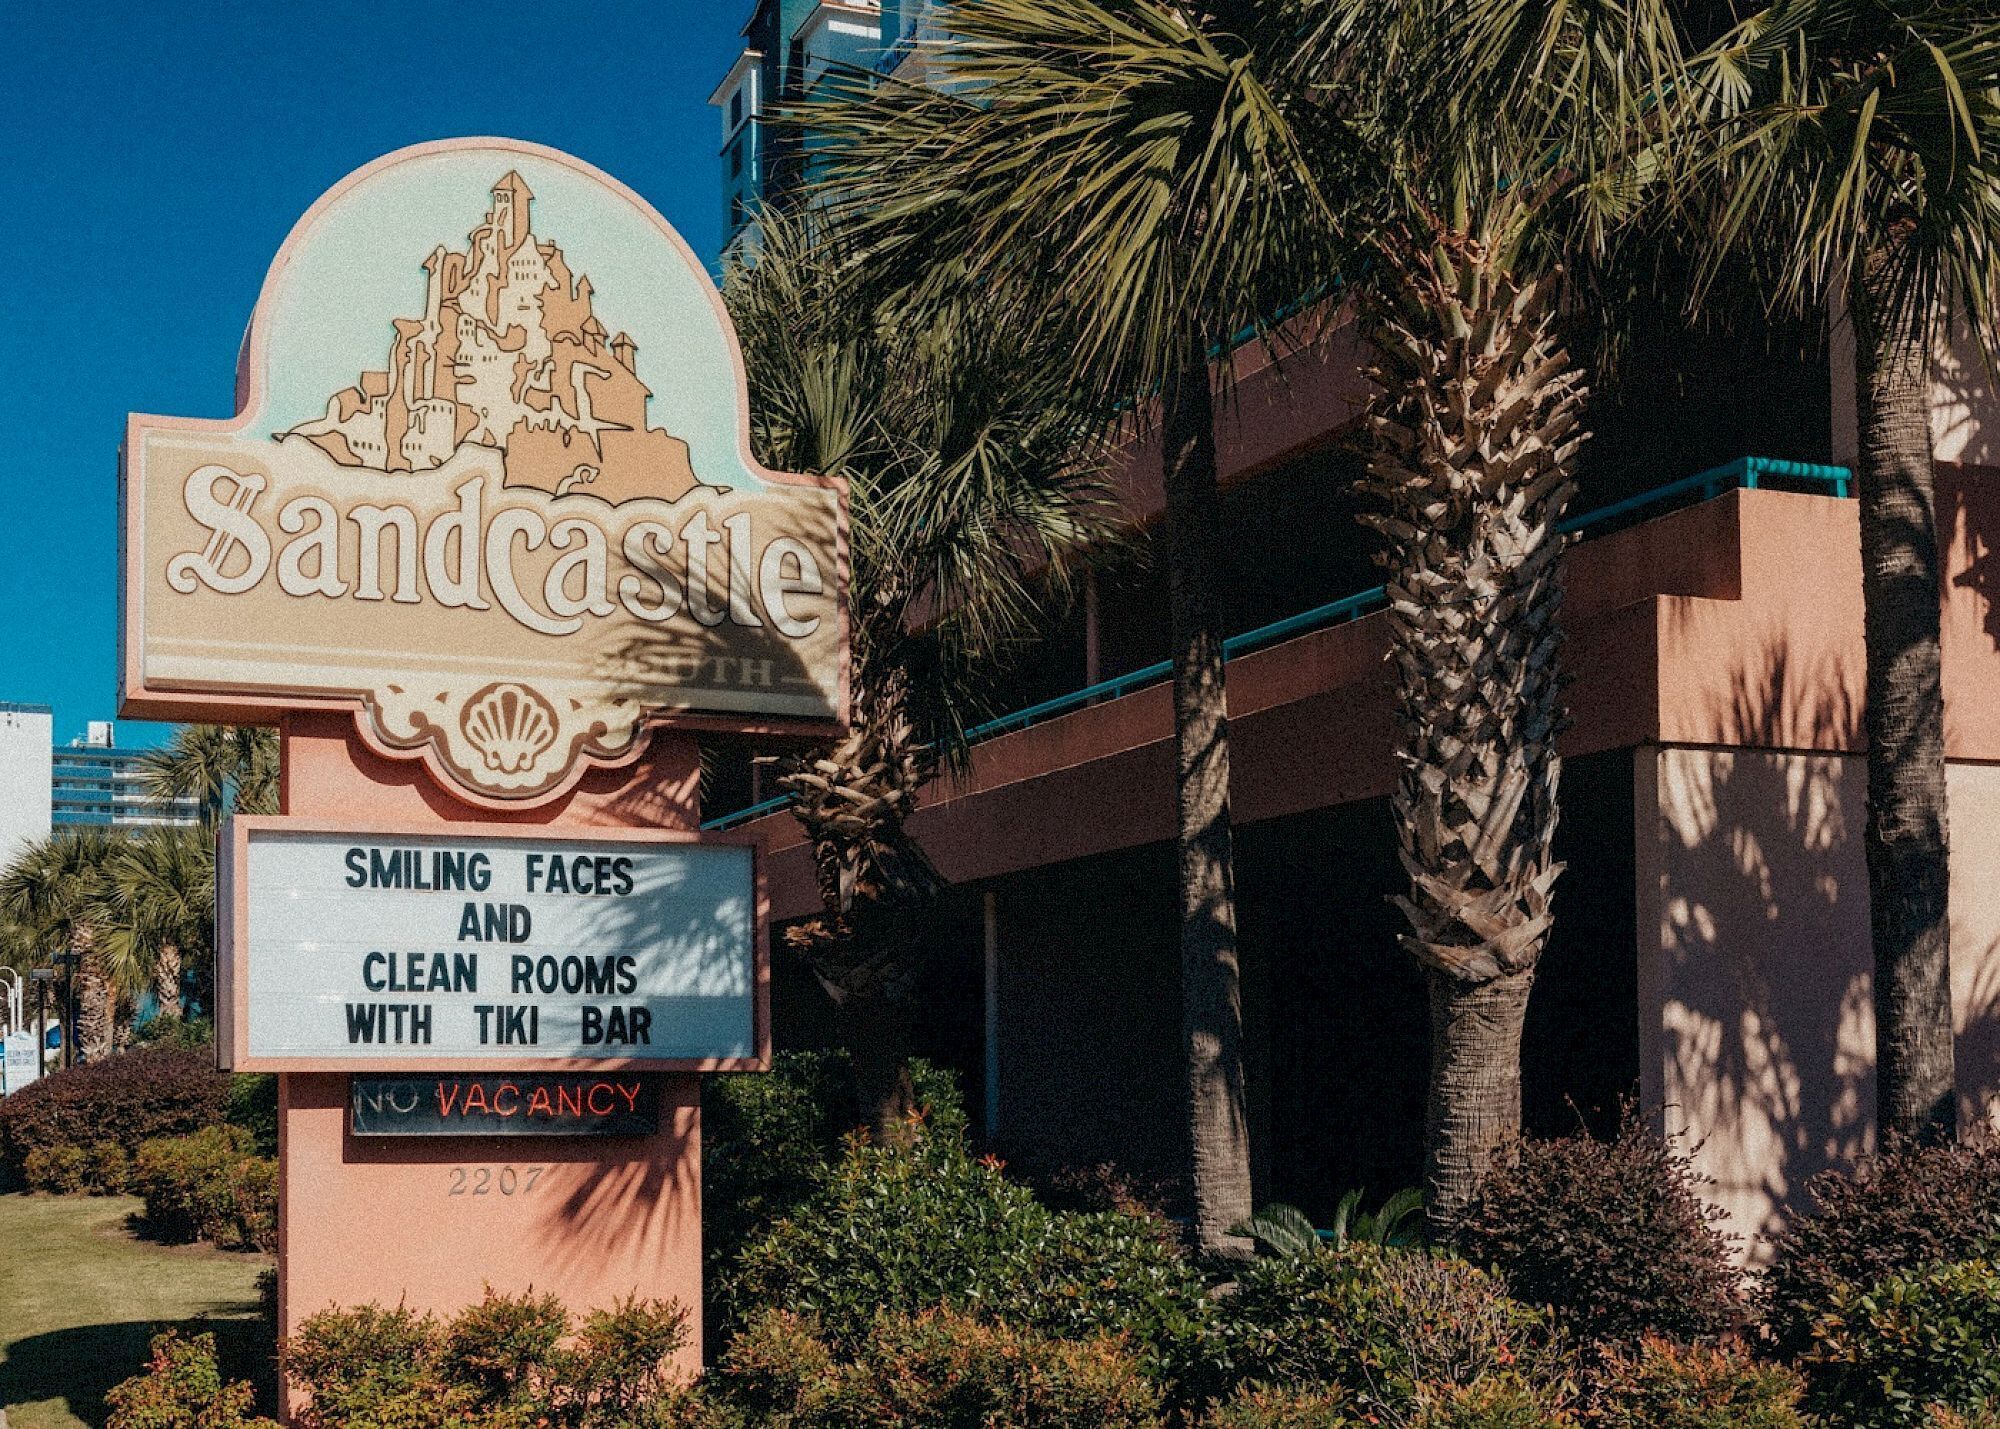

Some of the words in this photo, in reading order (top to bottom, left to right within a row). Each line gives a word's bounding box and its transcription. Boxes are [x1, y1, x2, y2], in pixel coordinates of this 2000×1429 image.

[165, 463, 825, 639] Sandcastle
[345, 847, 491, 892] SMILING
[526, 853, 634, 897] FACES
[457, 902, 532, 944] AND
[362, 951, 478, 993] CLEAN
[511, 954, 638, 995] ROOMS
[345, 1003, 432, 1045] WITH
[473, 1004, 539, 1046] TIKI
[580, 1005, 652, 1046] BAR
[353, 1080, 420, 1113] NO
[437, 1081, 641, 1117] VACANCY
[448, 1165, 546, 1197] 2207
